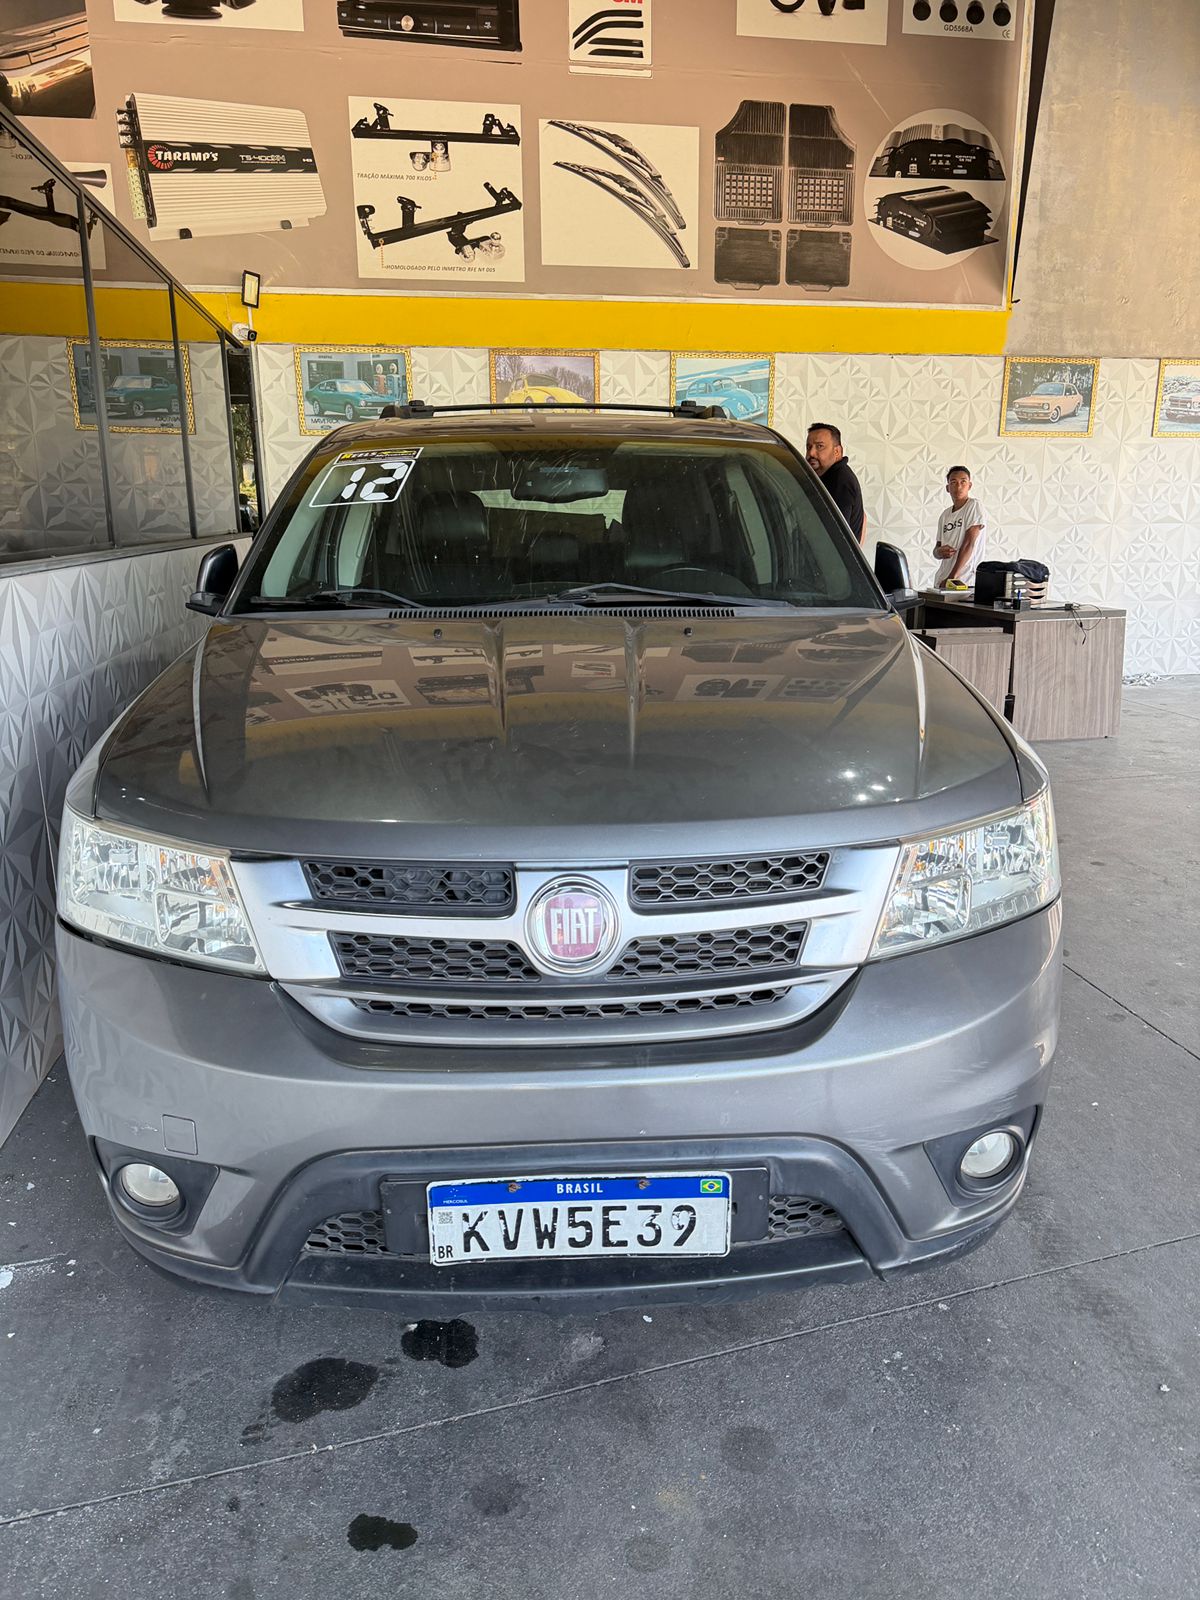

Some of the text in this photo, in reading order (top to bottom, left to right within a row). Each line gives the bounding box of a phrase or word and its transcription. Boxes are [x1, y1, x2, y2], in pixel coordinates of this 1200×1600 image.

[943, 24, 974, 33] GD5568A
[155, 150, 219, 161] TARAMP'S
[357, 172, 379, 180] TRAÇÃO
[380, 173, 404, 181] MÁXIMA
[341, 462, 409, 501] 12
[550, 908, 598, 945] FIAT
[556, 1182, 604, 1194] BRASIL
[461, 1204, 698, 1253] KVW5E39
[437, 1244, 454, 1259] BR
